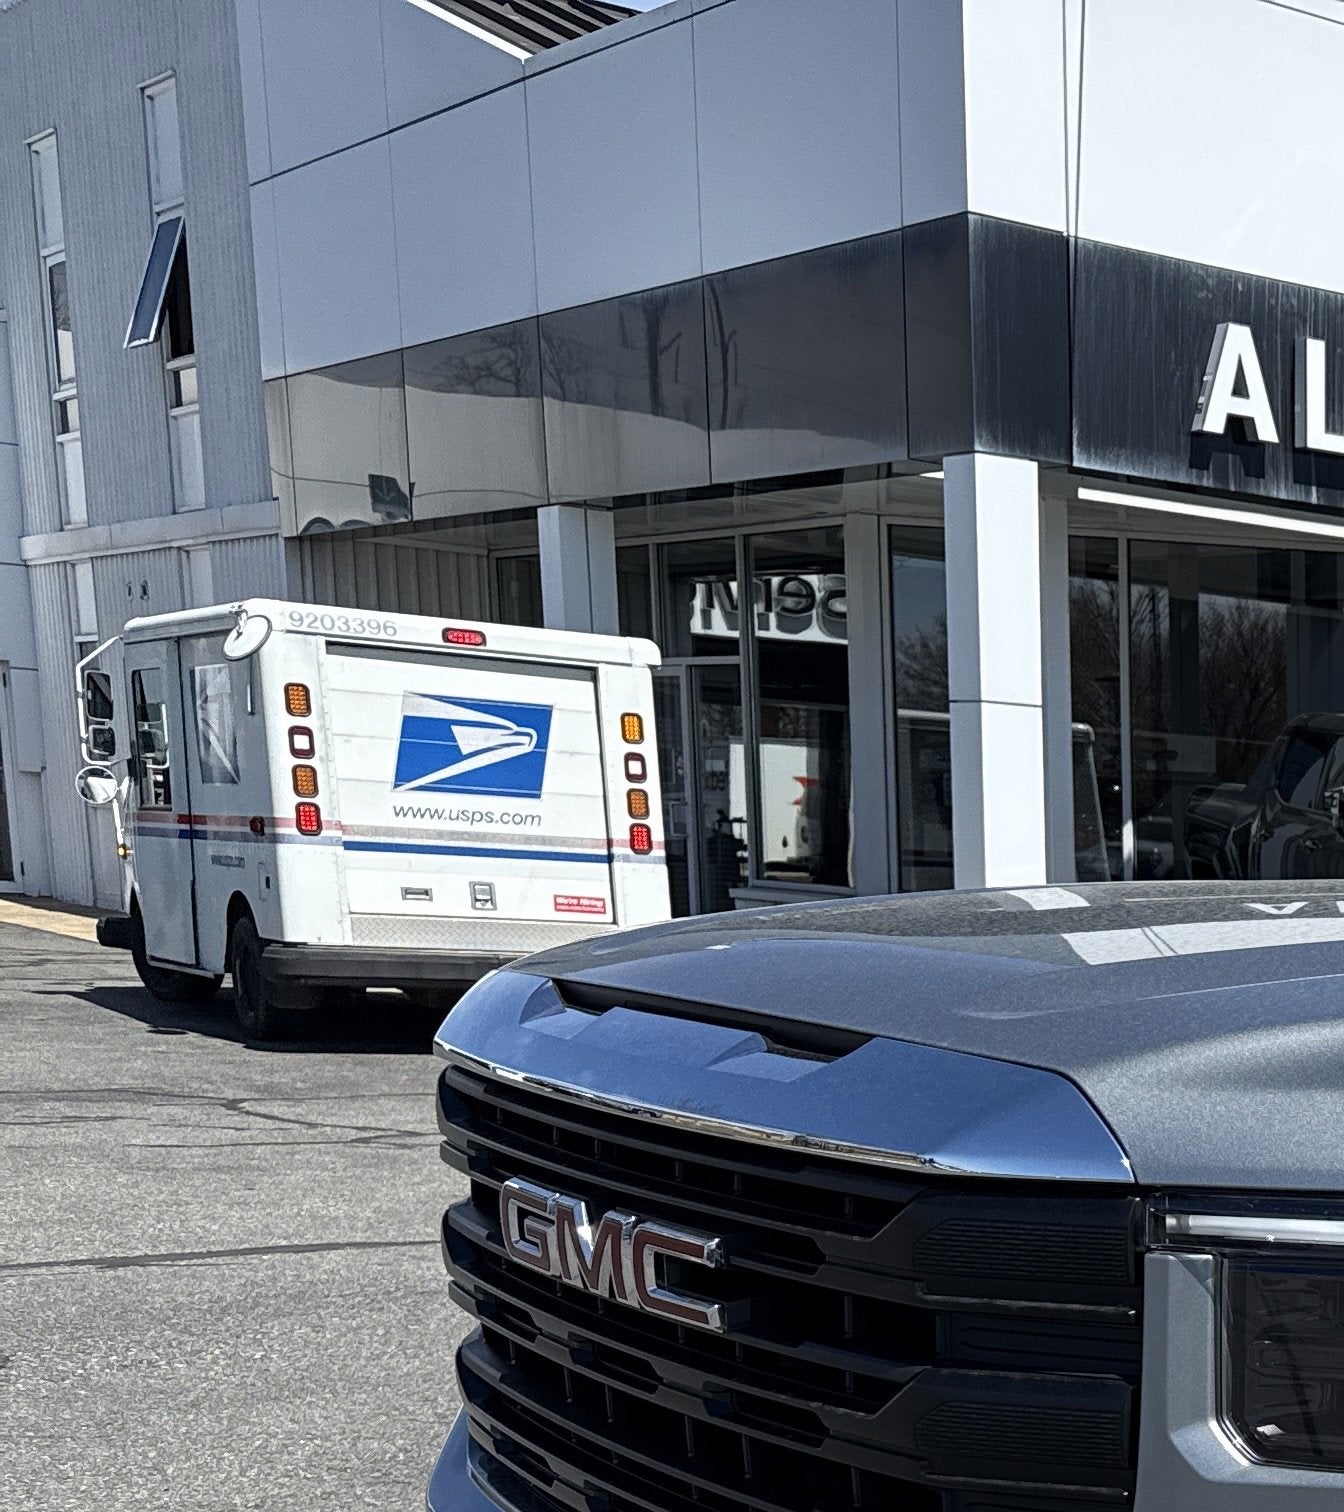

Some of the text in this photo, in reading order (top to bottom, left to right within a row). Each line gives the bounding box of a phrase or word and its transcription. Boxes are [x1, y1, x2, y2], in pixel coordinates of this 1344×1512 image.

[289, 610, 398, 637] 9203396
[393, 805, 542, 826] www.usps.com
[500, 1177, 725, 1333] GMC
